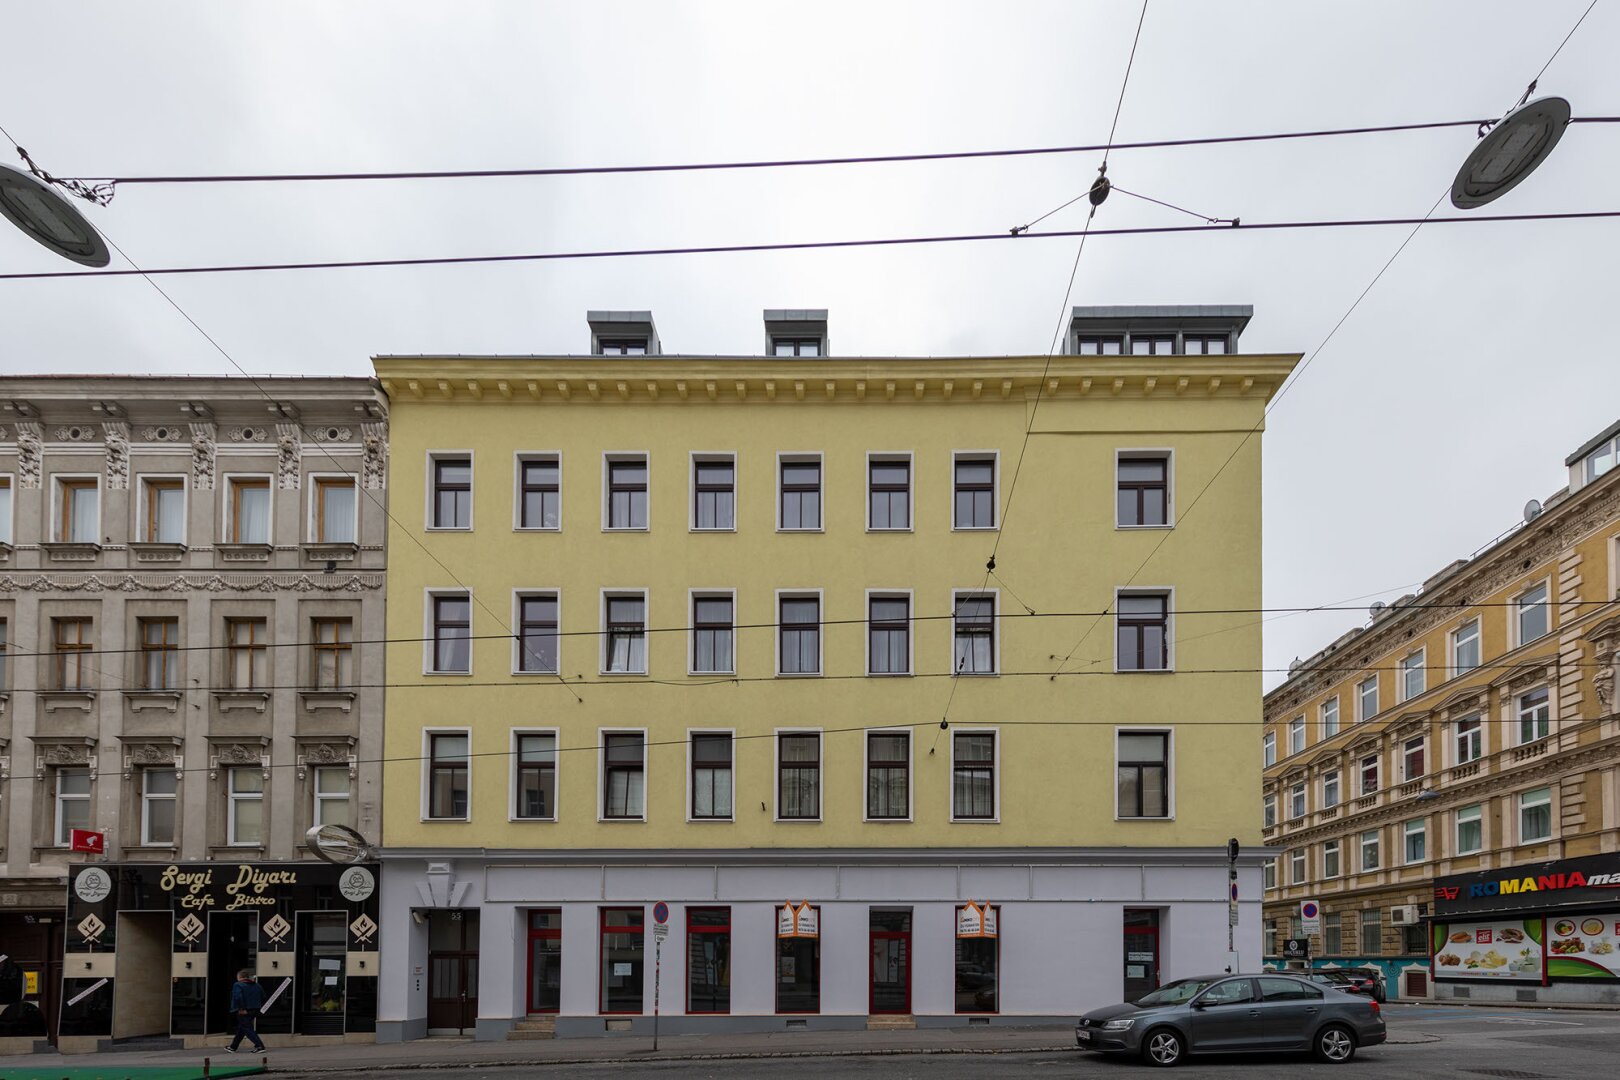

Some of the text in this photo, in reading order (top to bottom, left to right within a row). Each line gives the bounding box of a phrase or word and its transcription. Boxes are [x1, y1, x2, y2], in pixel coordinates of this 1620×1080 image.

[161, 865, 297, 895] Sevgi Diyarı
[1470, 871, 1587, 897] ROMANIA
[181, 893, 276, 911] Cafe Bistro
[452, 912, 462, 921] 55
